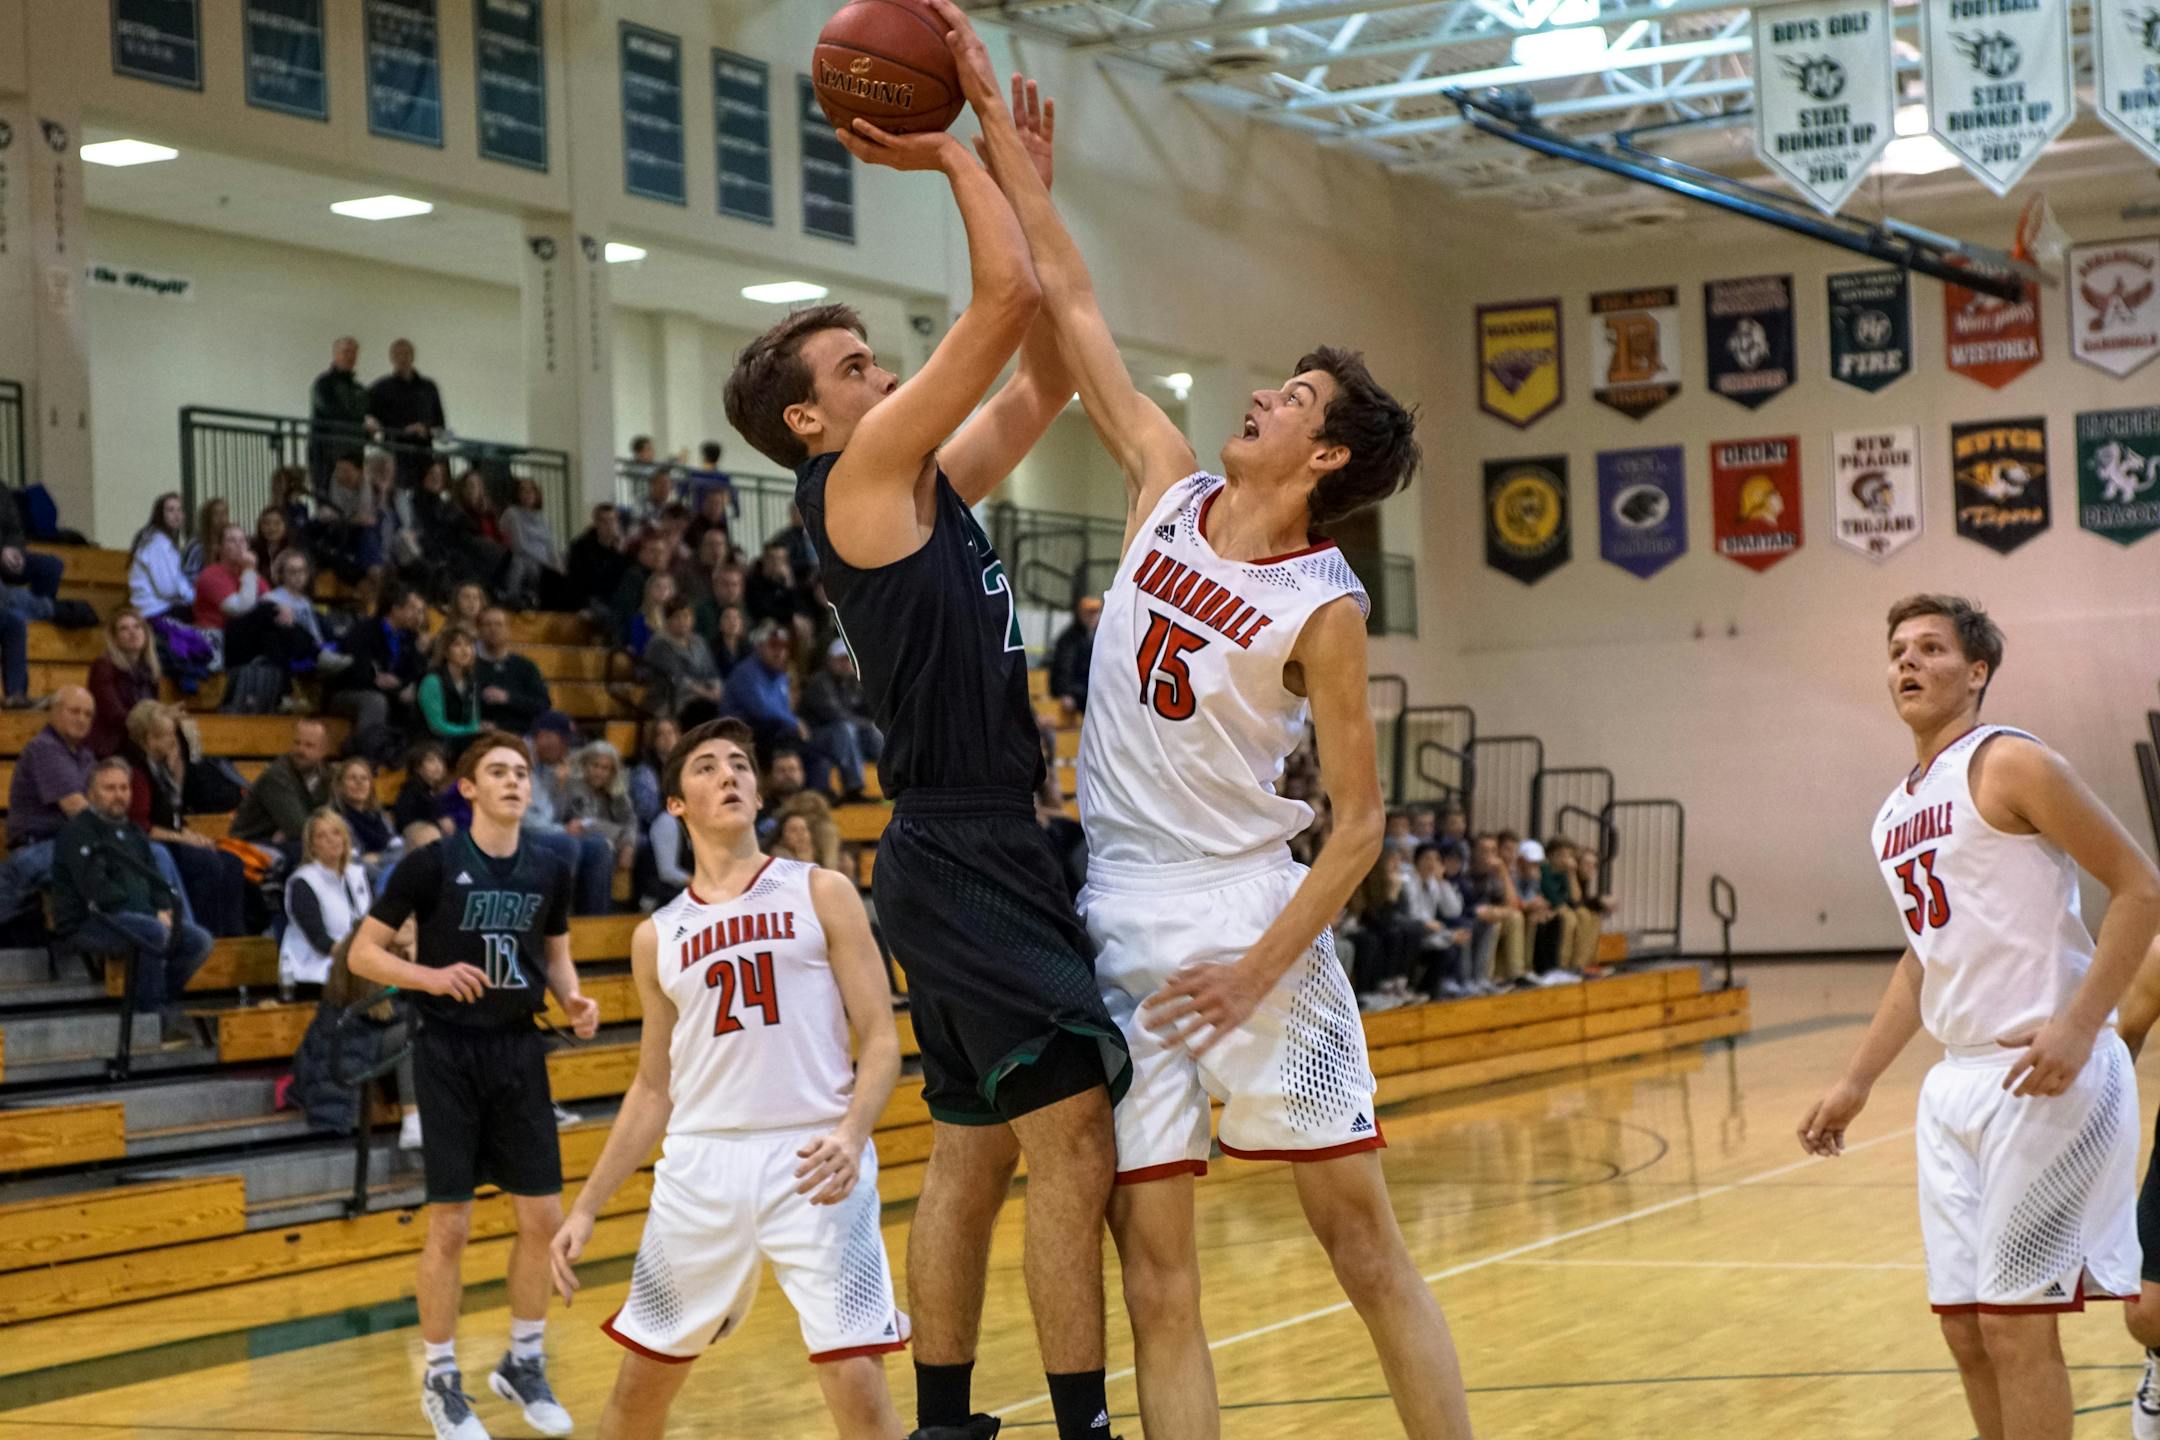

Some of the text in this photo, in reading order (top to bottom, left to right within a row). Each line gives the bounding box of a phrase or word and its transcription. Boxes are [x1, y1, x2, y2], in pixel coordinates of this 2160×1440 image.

[1772, 11, 1870, 43] BOYS GOLF
[819, 57, 914, 111] SPALDING
[1973, 81, 2025, 106] STATE
[1799, 103, 1849, 128] STATE
[1947, 101, 2052, 131] RUNNER UP
[1776, 123, 1876, 152] RUNNER UP
[1839, 348, 1902, 375] FIRE
[1720, 441, 1787, 467] ORONO
[1854, 434, 1894, 451] NEW
[1956, 428, 2043, 458] HUTCH
[1840, 451, 1910, 469] PRAGUE
[1132, 549, 1273, 650] ANNANDALE
[1136, 608, 1210, 721] 15
[1894, 848, 1952, 936] 33
[458, 890, 545, 932] FIRE
[680, 911, 796, 973] ANNANDALE
[480, 933, 529, 989] 12
[705, 951, 781, 1038] 24
